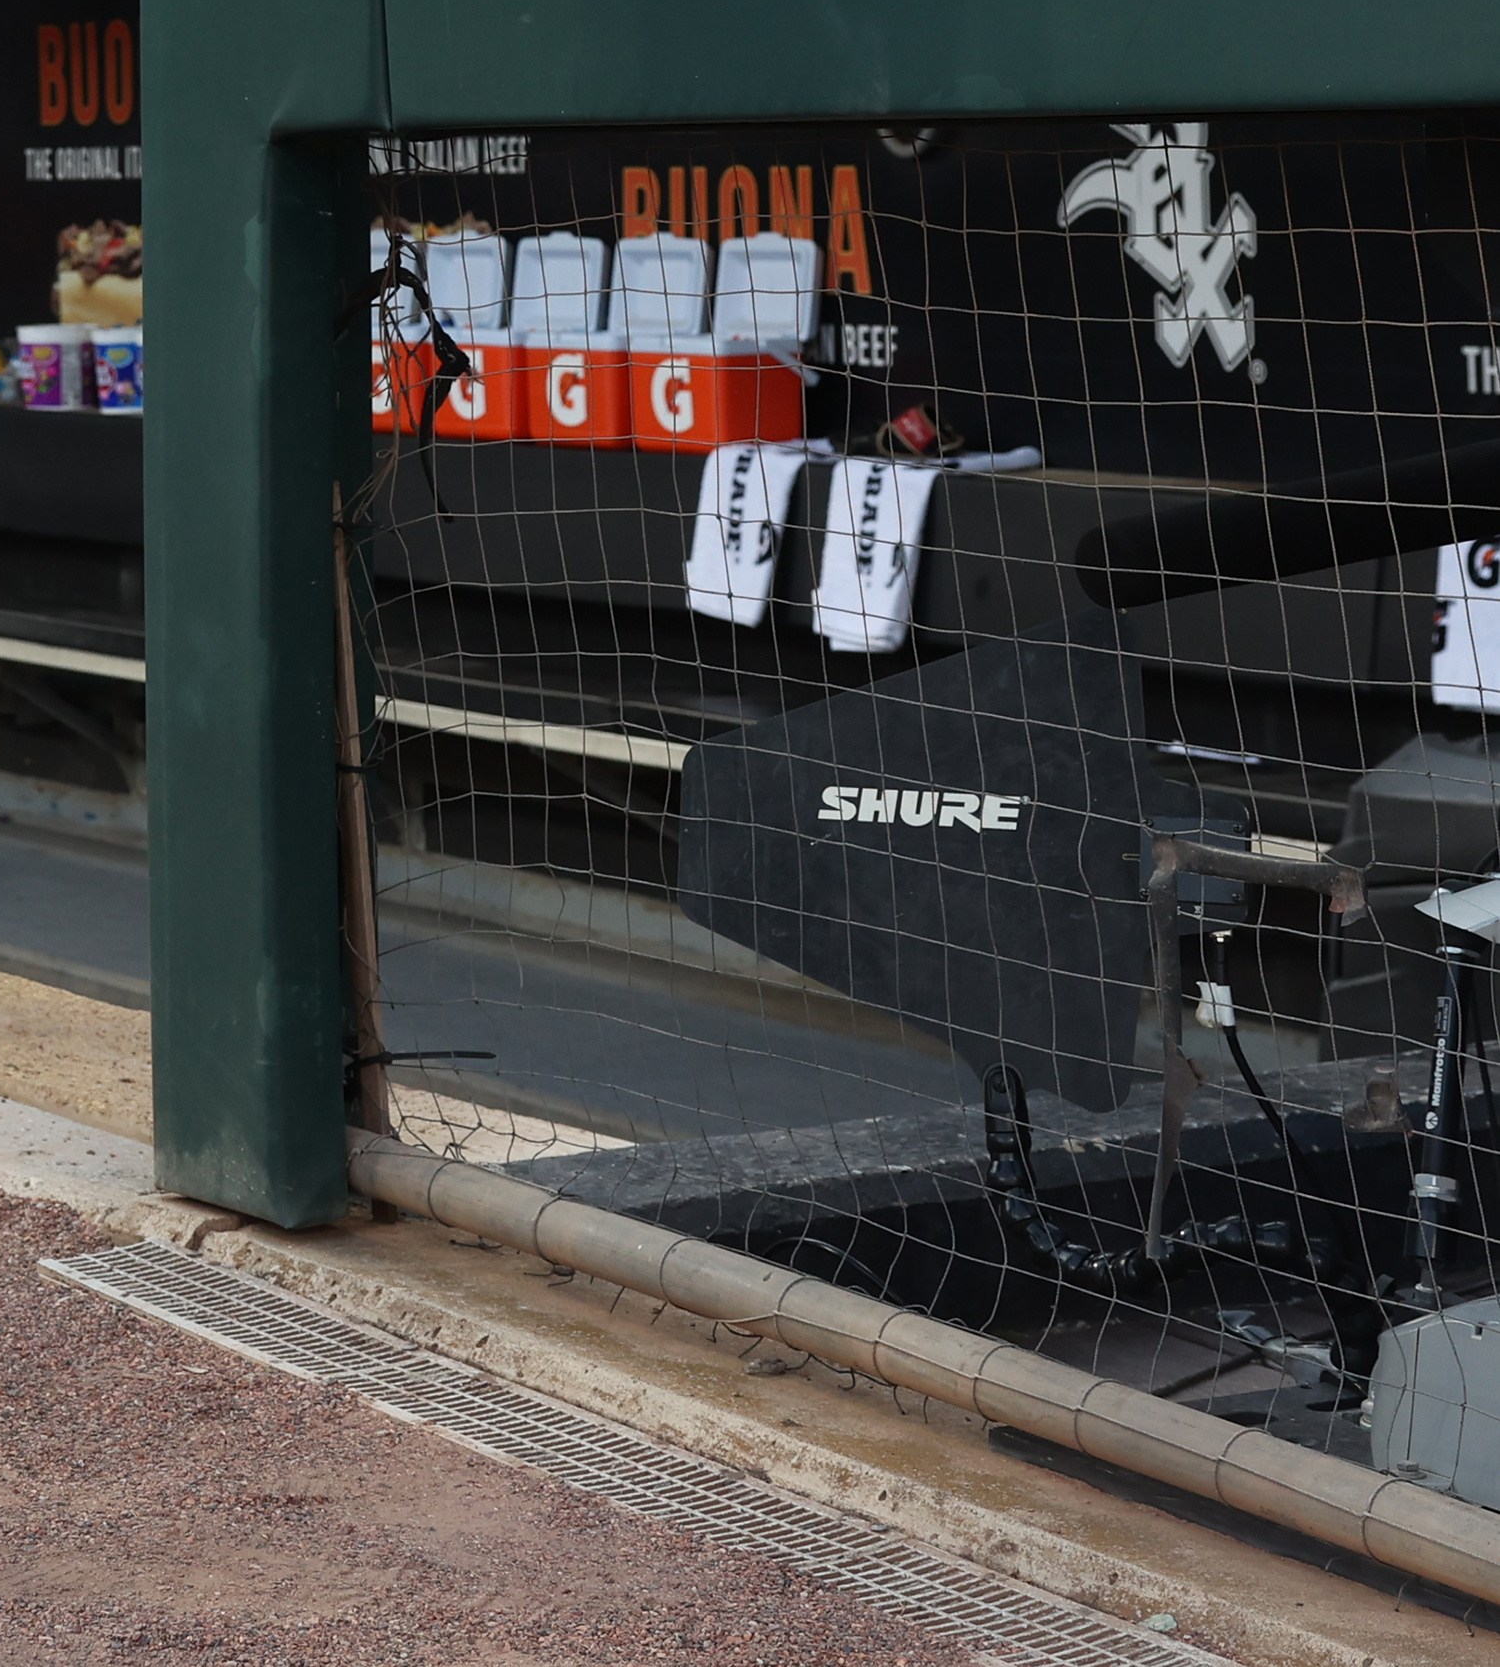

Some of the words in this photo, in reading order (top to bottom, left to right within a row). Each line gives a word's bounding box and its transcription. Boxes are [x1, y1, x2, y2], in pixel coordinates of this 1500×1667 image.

[37, 19, 134, 126] BUO
[25, 148, 53, 180] THE
[55, 146, 122, 180] ORIGINAL
[484, 134, 530, 174] BEEF
[621, 165, 871, 295] BUONA
[842, 323, 898, 367] BEEF
[547, 352, 588, 427] G
[651, 358, 694, 433] G
[818, 785, 1021, 834] SHURE
[1431, 1038, 1446, 1107] Manfrotto
